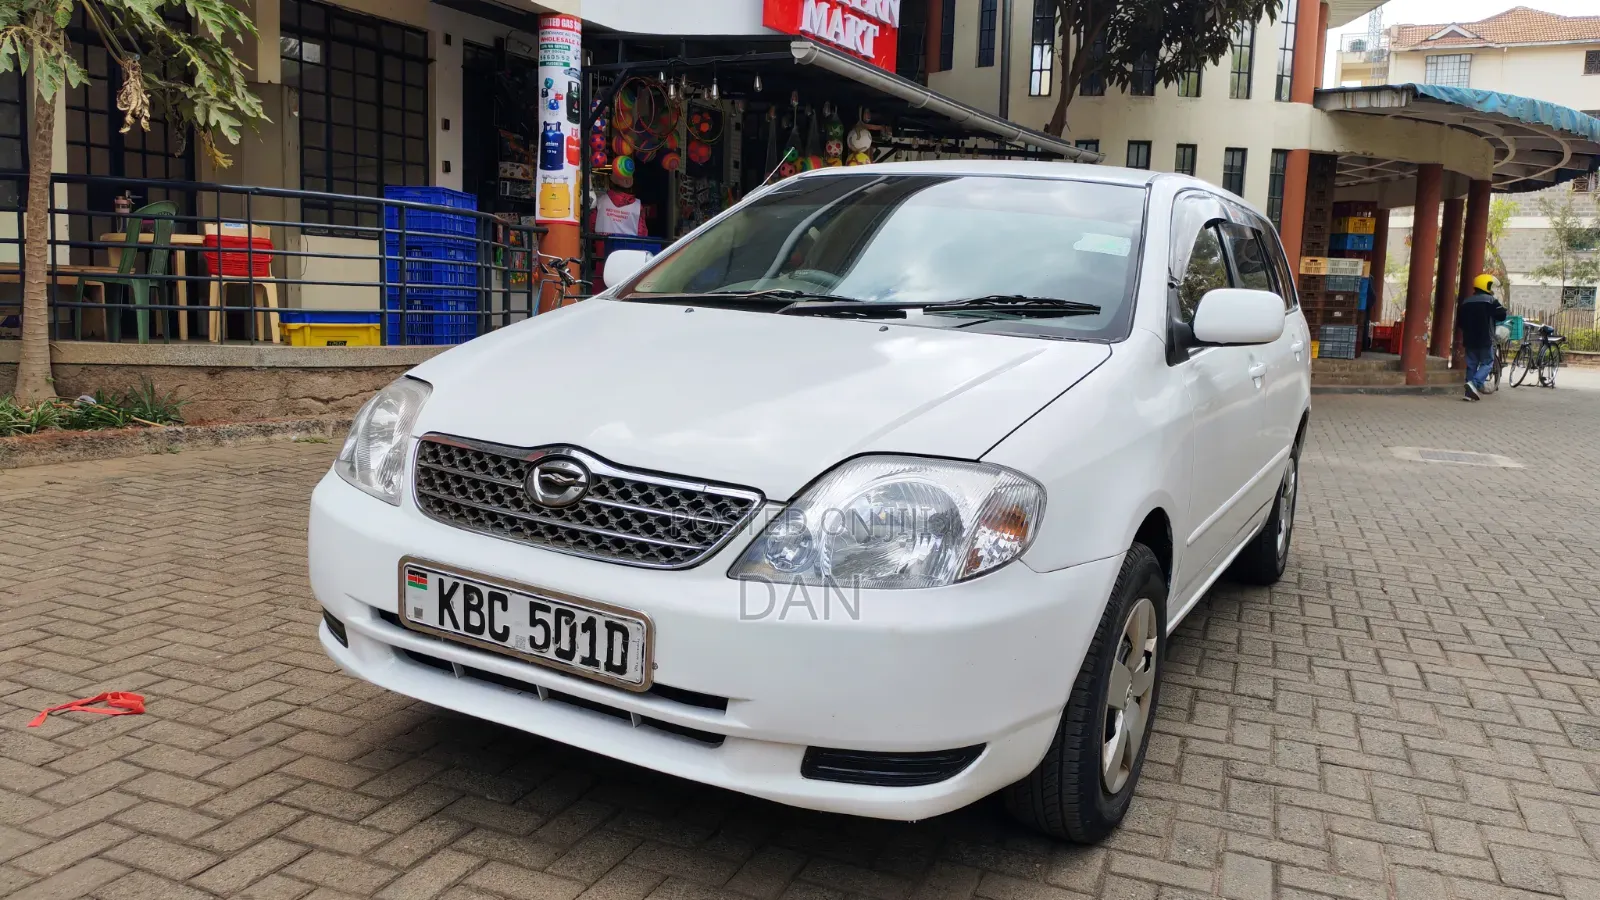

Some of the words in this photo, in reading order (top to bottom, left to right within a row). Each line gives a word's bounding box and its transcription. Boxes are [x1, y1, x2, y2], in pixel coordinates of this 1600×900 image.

[561, 18, 574, 29] GAS
[799, 0, 879, 58] MART
[541, 37, 575, 45] WHOLESALE
[438, 577, 511, 643] KBC
[528, 600, 630, 676] 501D
